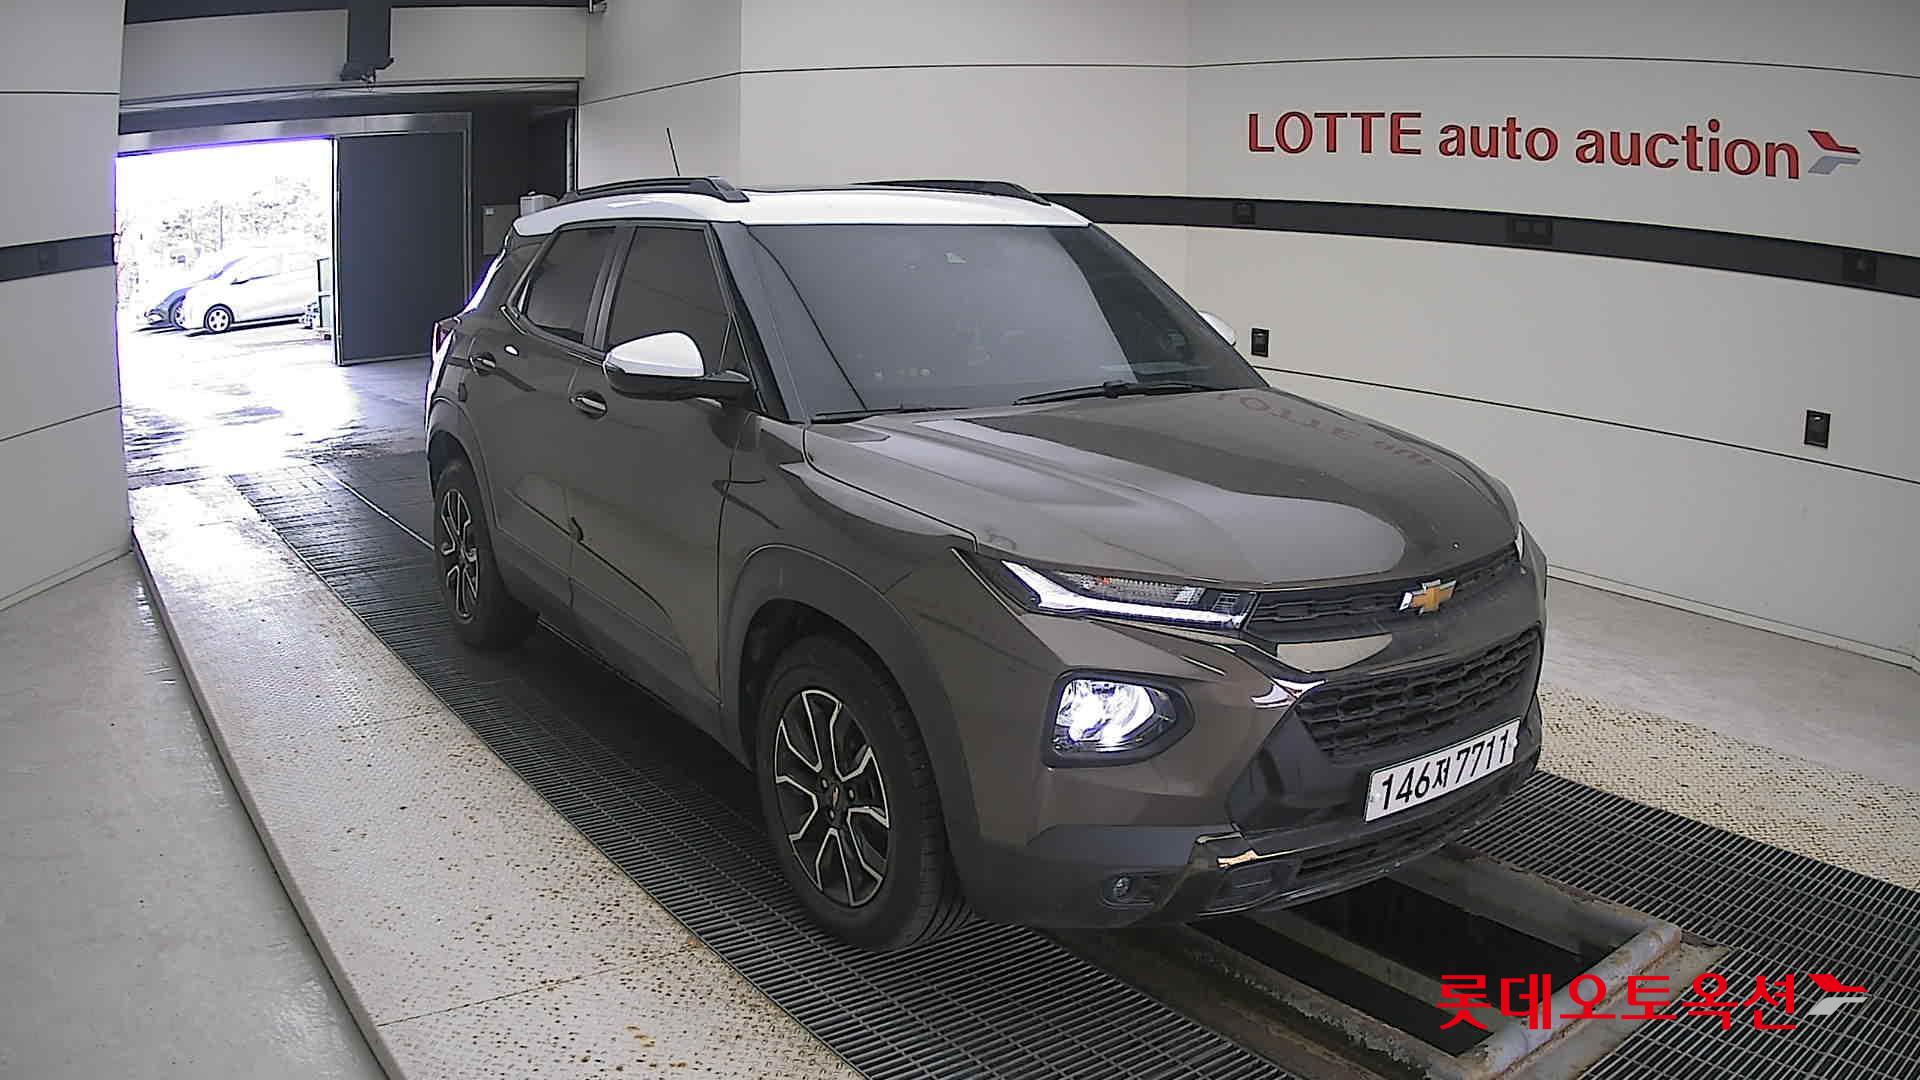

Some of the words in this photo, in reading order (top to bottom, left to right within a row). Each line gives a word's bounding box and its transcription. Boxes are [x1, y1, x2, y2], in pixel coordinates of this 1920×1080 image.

[1248, 112, 1422, 155] LOTTE
[1439, 116, 1559, 162] auto
[1575, 119, 1800, 180] auction
